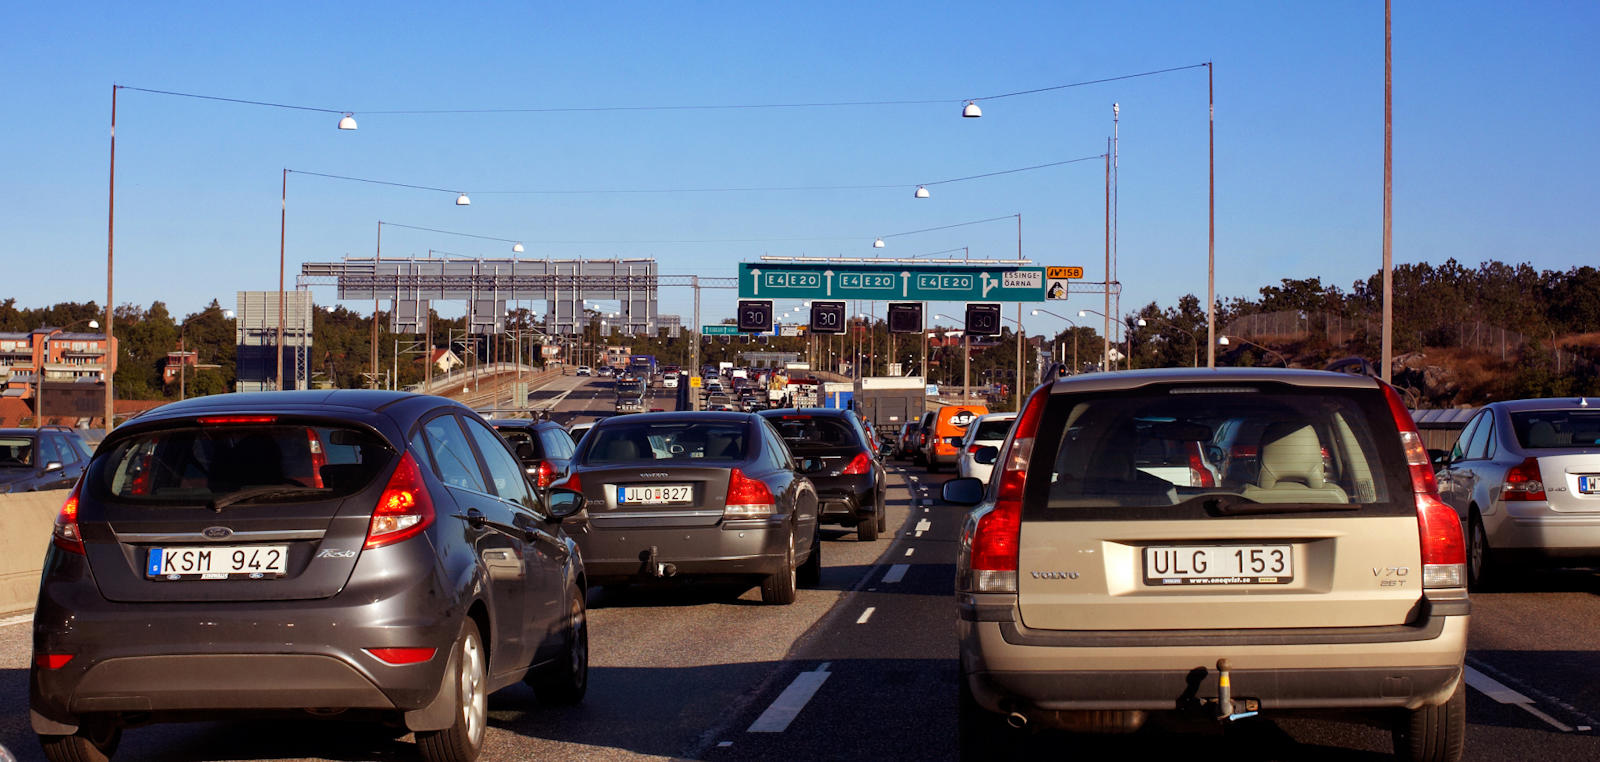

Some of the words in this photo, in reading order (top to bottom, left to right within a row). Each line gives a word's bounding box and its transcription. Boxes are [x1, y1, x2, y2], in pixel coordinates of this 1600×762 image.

[1063, 269, 1079, 277] 158
[791, 275, 816, 285] E20
[865, 276, 891, 286] E20
[943, 278, 969, 287] E20
[1004, 279, 1032, 287] ÖARNA
[747, 311, 764, 325] 30
[820, 312, 836, 326] 30
[975, 315, 992, 328] 30
[627, 488, 652, 501] JLO
[662, 487, 688, 500] 827
[164, 550, 212, 572] KSM
[232, 549, 280, 571] 942
[1154, 550, 1207, 574] ULG
[1235, 549, 1285, 574] 153
[1031, 571, 1080, 580] VOLVO
